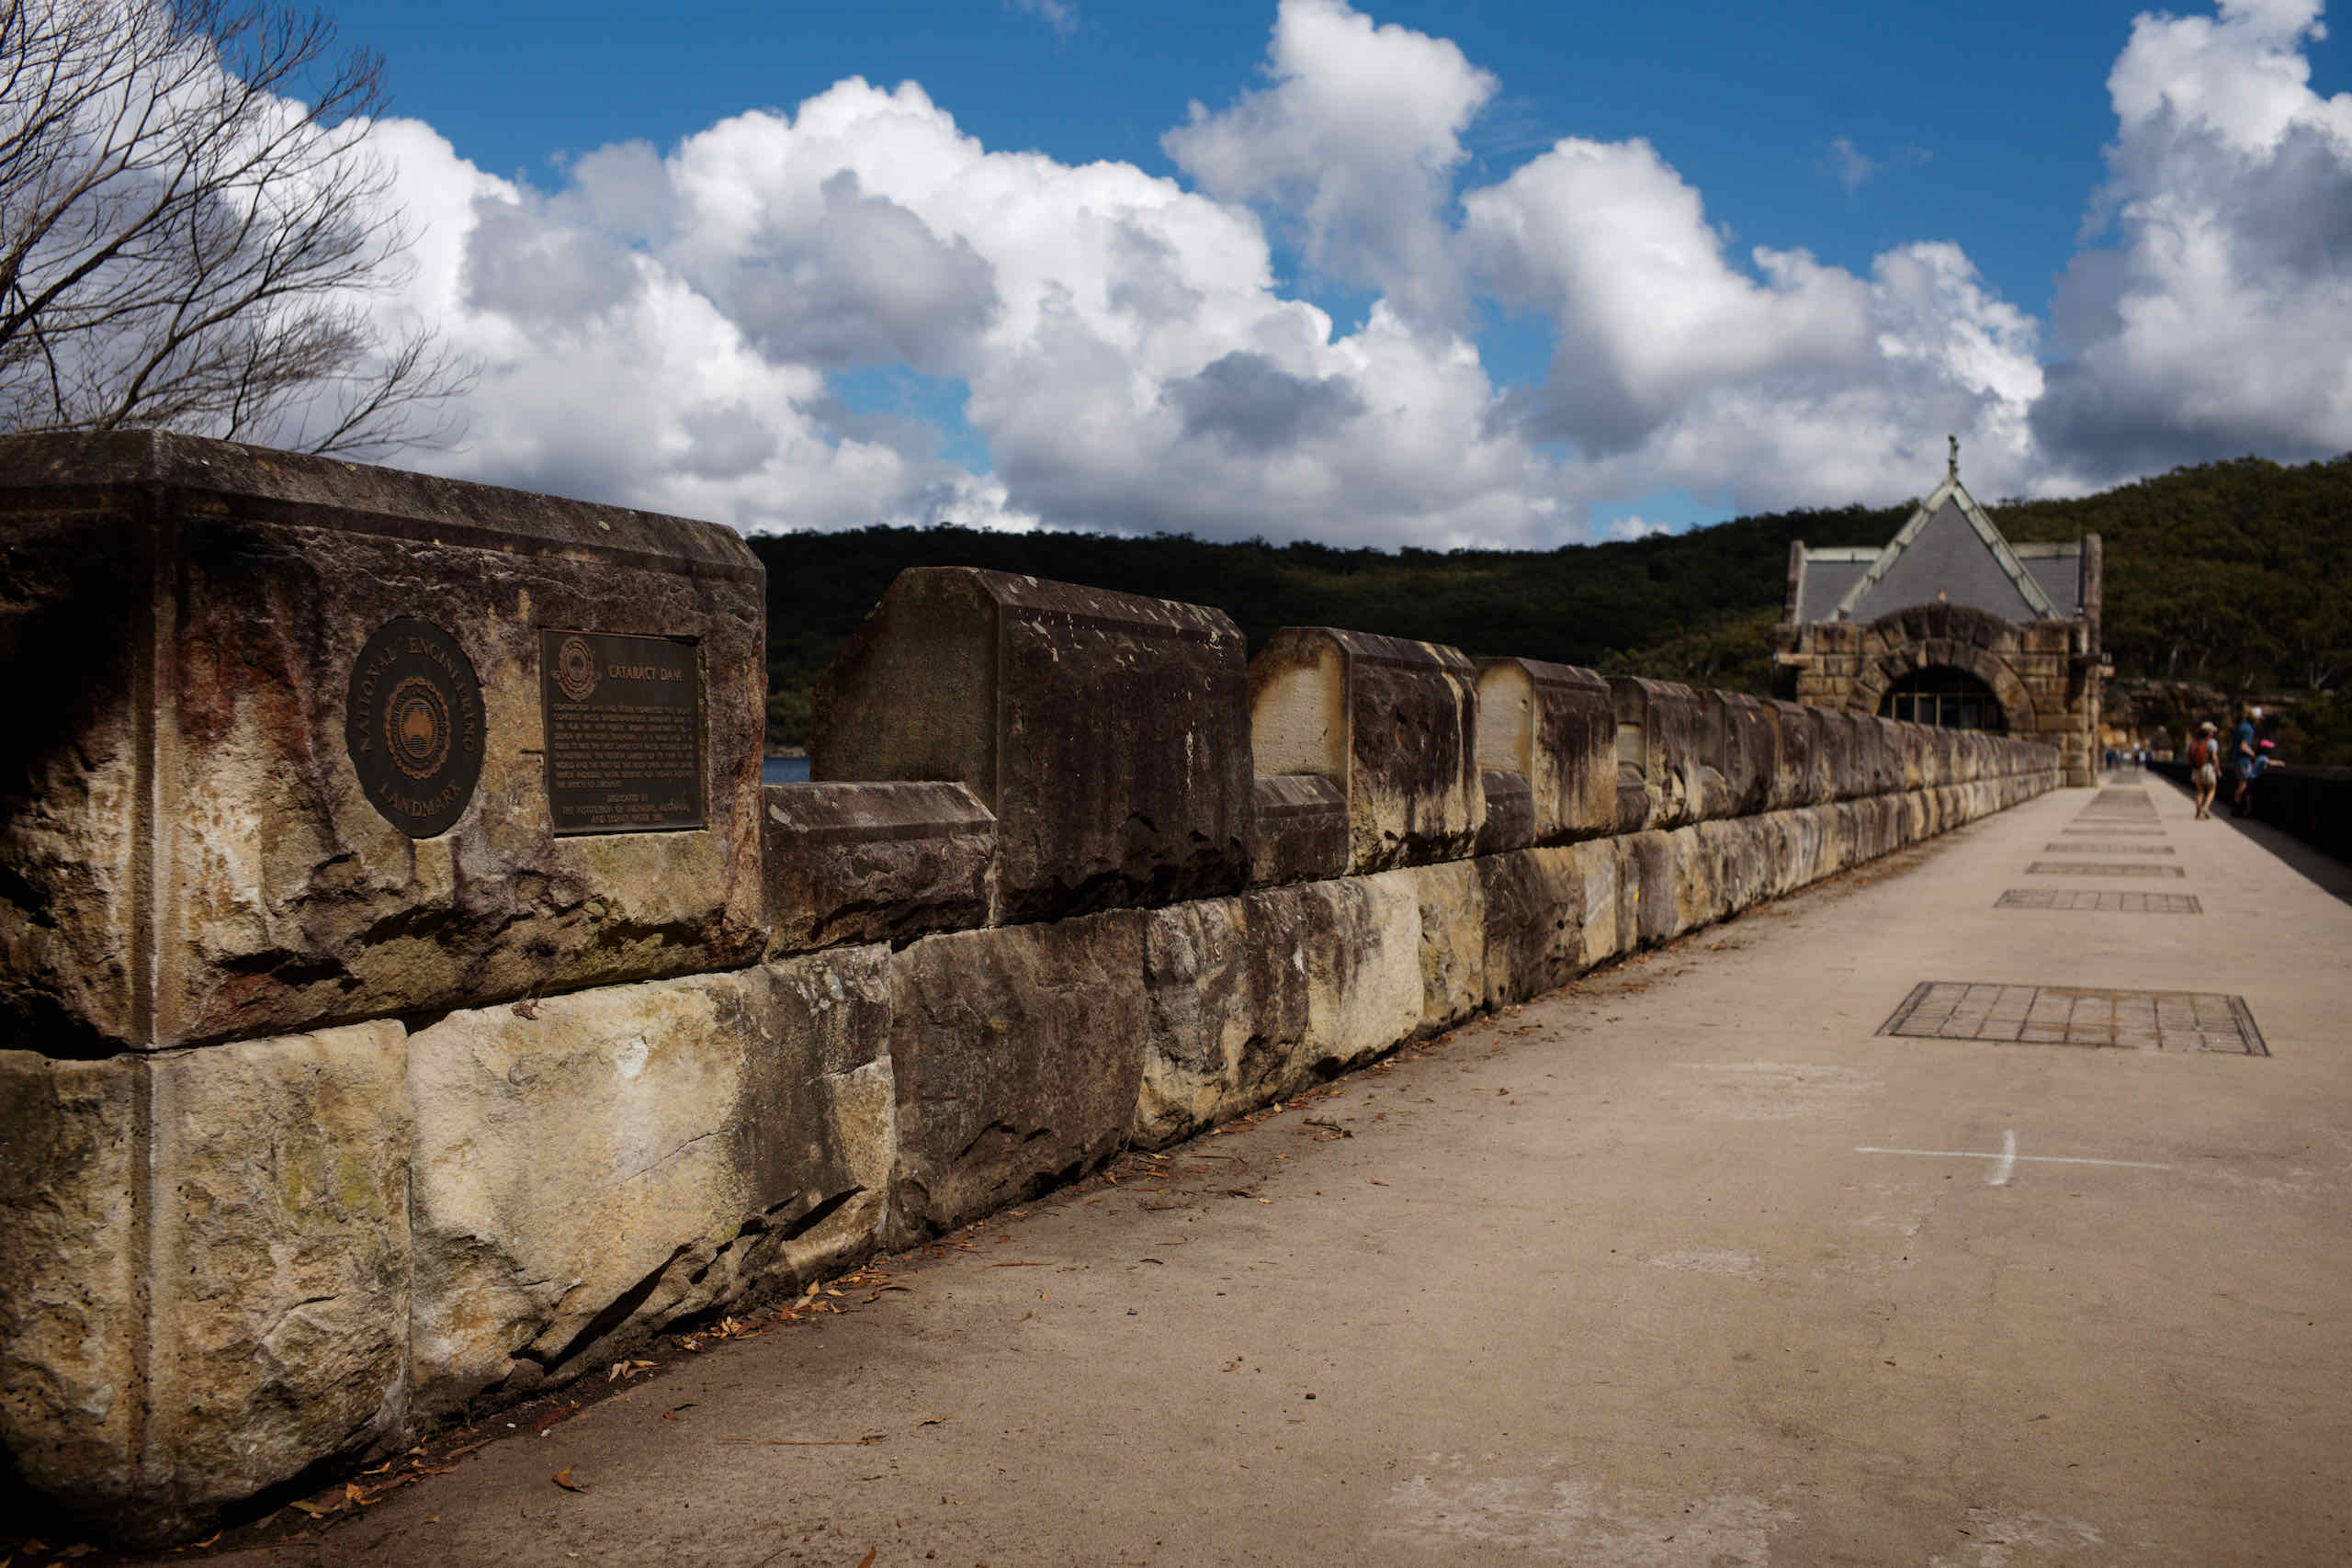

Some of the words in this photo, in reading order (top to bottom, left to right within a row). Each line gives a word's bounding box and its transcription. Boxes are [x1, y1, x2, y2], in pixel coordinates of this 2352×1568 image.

[608, 665, 656, 681] CATARACT
[660, 669, 682, 682] DAM
[357, 647, 397, 751] NATIONAL
[405, 637, 476, 750] ENGINEERING
[378, 780, 461, 818] LANDMARK
